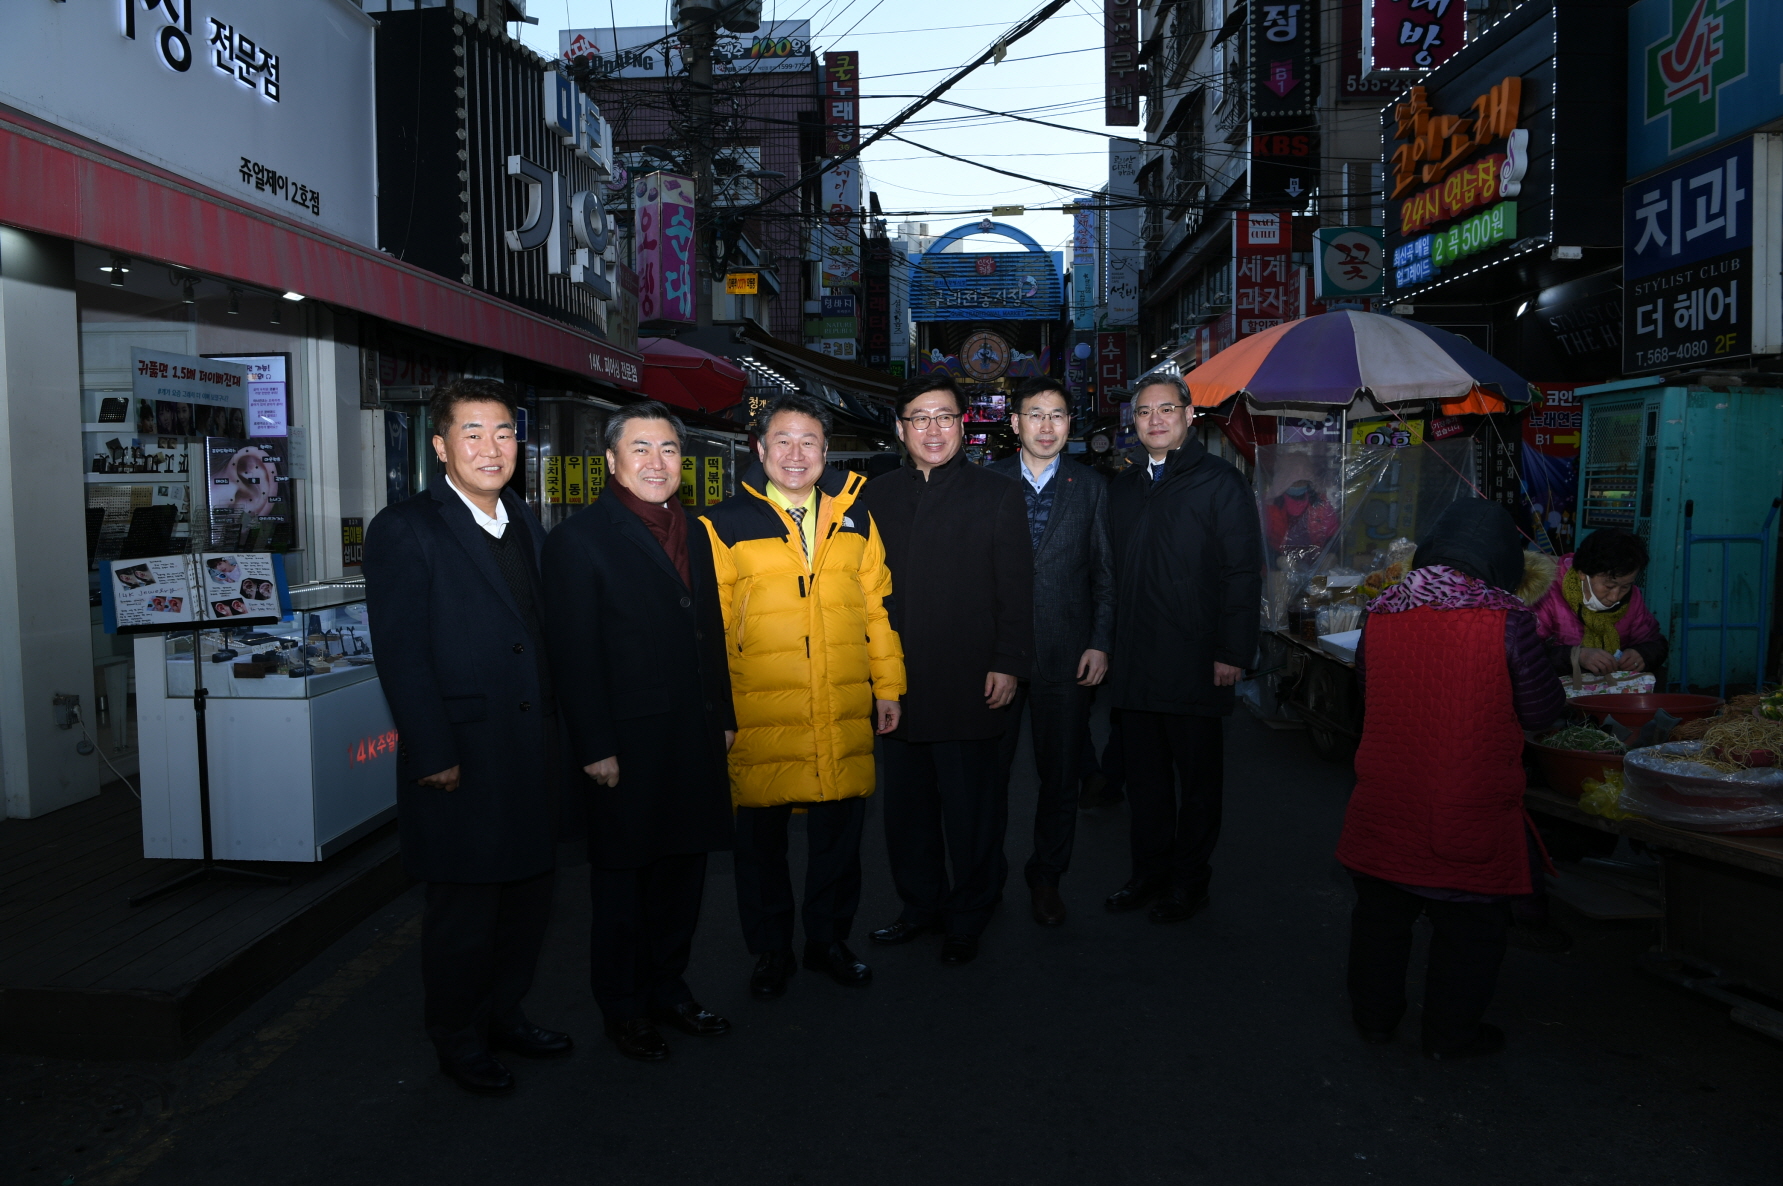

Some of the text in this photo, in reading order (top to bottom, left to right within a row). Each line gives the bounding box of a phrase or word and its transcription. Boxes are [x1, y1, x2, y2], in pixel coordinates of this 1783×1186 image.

[208, 17, 280, 103] 전문점
[751, 35, 806, 58] 100원
[832, 82, 857, 144] 노래방
[1253, 135, 1309, 156] KBS
[239, 156, 320, 216] 쥬얼제이 2호점
[1401, 158, 1497, 232] 24시 연습장
[1634, 156, 1745, 256] 치과
[1251, 230, 1276, 238] OUTLET
[1462, 206, 1504, 250] 500원
[665, 206, 694, 317] 순대
[1238, 254, 1287, 283] 세계
[1334, 243, 1370, 281] 꽃
[1635, 258, 1740, 296] STYLIST CLUB
[930, 288, 1030, 309] 구리전통시장
[1238, 286, 1288, 315] 과자
[1605, 300, 1622, 320] CL
[1636, 279, 1737, 339] 더 헤어
[870, 354, 886, 363] B1
[1636, 333, 1737, 367] T.568-4080 2F
[620, 359, 638, 383] 전문점
[748, 396, 772, 410] 청개
[1545, 389, 1581, 407] 코인2
[1529, 411, 1582, 429] 노래연습
[1535, 434, 1551, 445] B1
[547, 457, 560, 495] 잔치국수
[568, 457, 581, 496] 우동
[590, 457, 603, 496] 꼬마김밥
[682, 457, 694, 497] 순대
[707, 458, 720, 498] 떡볶이
[343, 526, 363, 544] 금이빨
[344, 545, 363, 563] 삽니다
